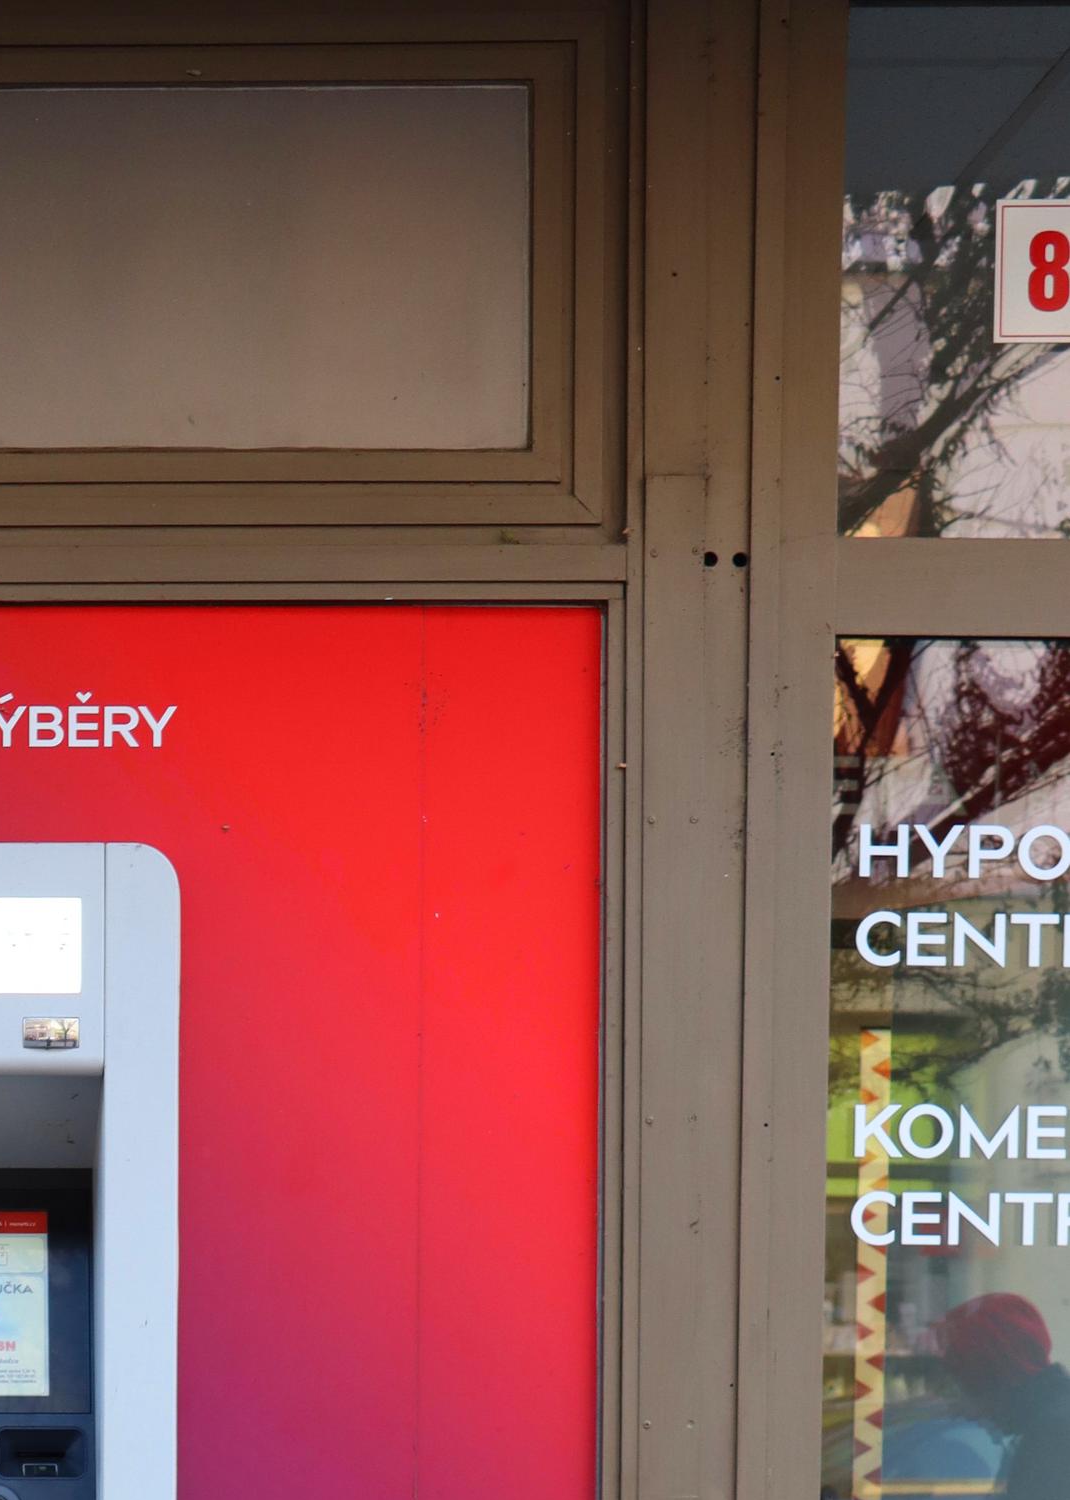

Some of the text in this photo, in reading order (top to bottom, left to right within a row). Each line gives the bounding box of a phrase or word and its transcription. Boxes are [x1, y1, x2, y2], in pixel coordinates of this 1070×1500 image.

[857, 823, 1070, 880] HYPO
[855, 911, 1070, 968] CENT
[853, 1103, 1068, 1160] KOME
